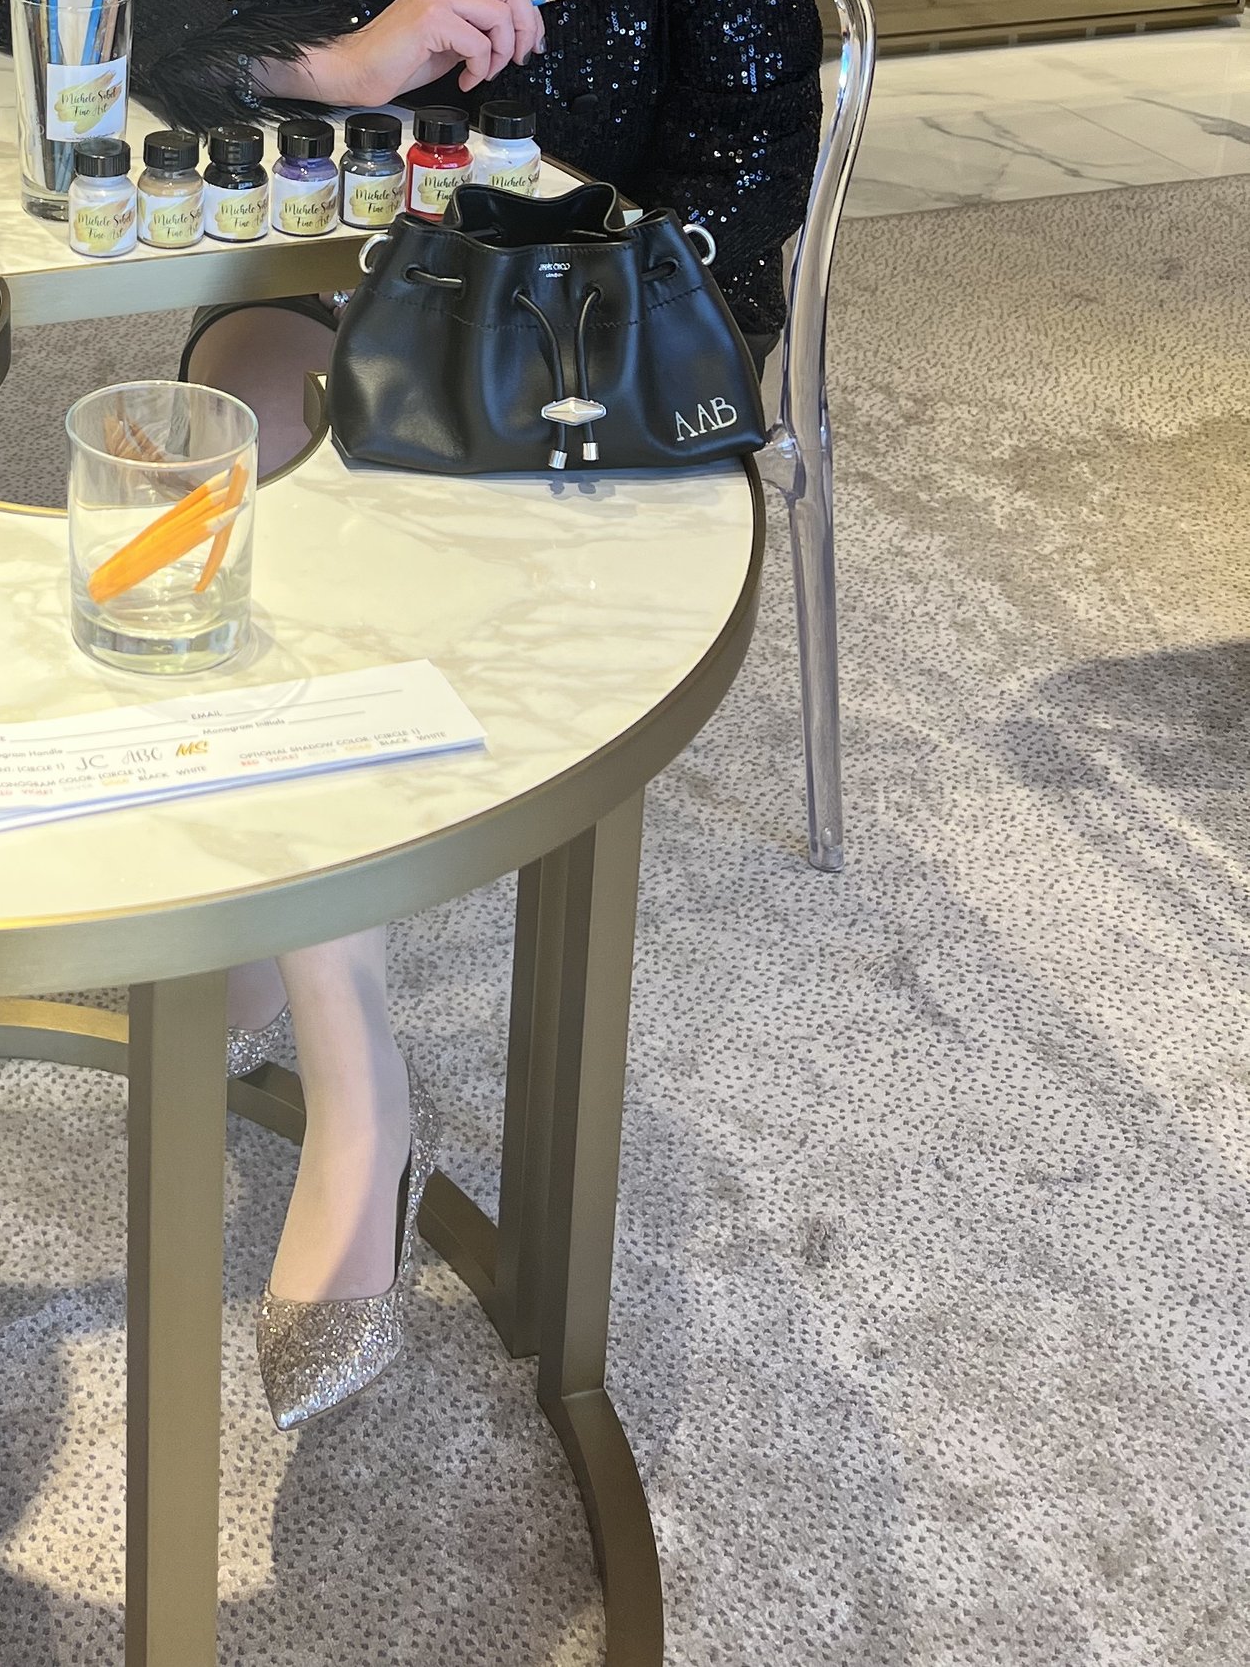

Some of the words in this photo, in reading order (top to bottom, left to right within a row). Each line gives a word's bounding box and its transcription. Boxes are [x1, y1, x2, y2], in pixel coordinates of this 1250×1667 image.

[61, 92, 96, 105] Michele
[98, 87, 117, 101] Sobel
[72, 105, 90, 117] Fine
[93, 103, 108, 116] Art
[424, 175, 458, 188] Michele
[491, 175, 526, 188] Michele
[355, 188, 390, 200] Michele
[221, 202, 255, 215] Michele
[284, 202, 318, 215] Michele
[366, 202, 384, 214] Fine
[78, 213, 110, 226] Michele
[153, 212, 188, 226] Michele
[232, 216, 250, 228] Fine
[294, 216, 312, 228] Fine
[88, 227, 105, 239] Fine
[164, 226, 184, 238] Fine
[675, 397, 738, 442] AAB
[191, 710, 222, 720] EMAIL
[29, 748, 63, 757] Handle
[202, 723, 253, 735] Monogram
[75, 754, 109, 771] JC
[121, 747, 163, 765] ABC
[175, 740, 209, 758] MS
[176, 766, 206, 776] WHITE
